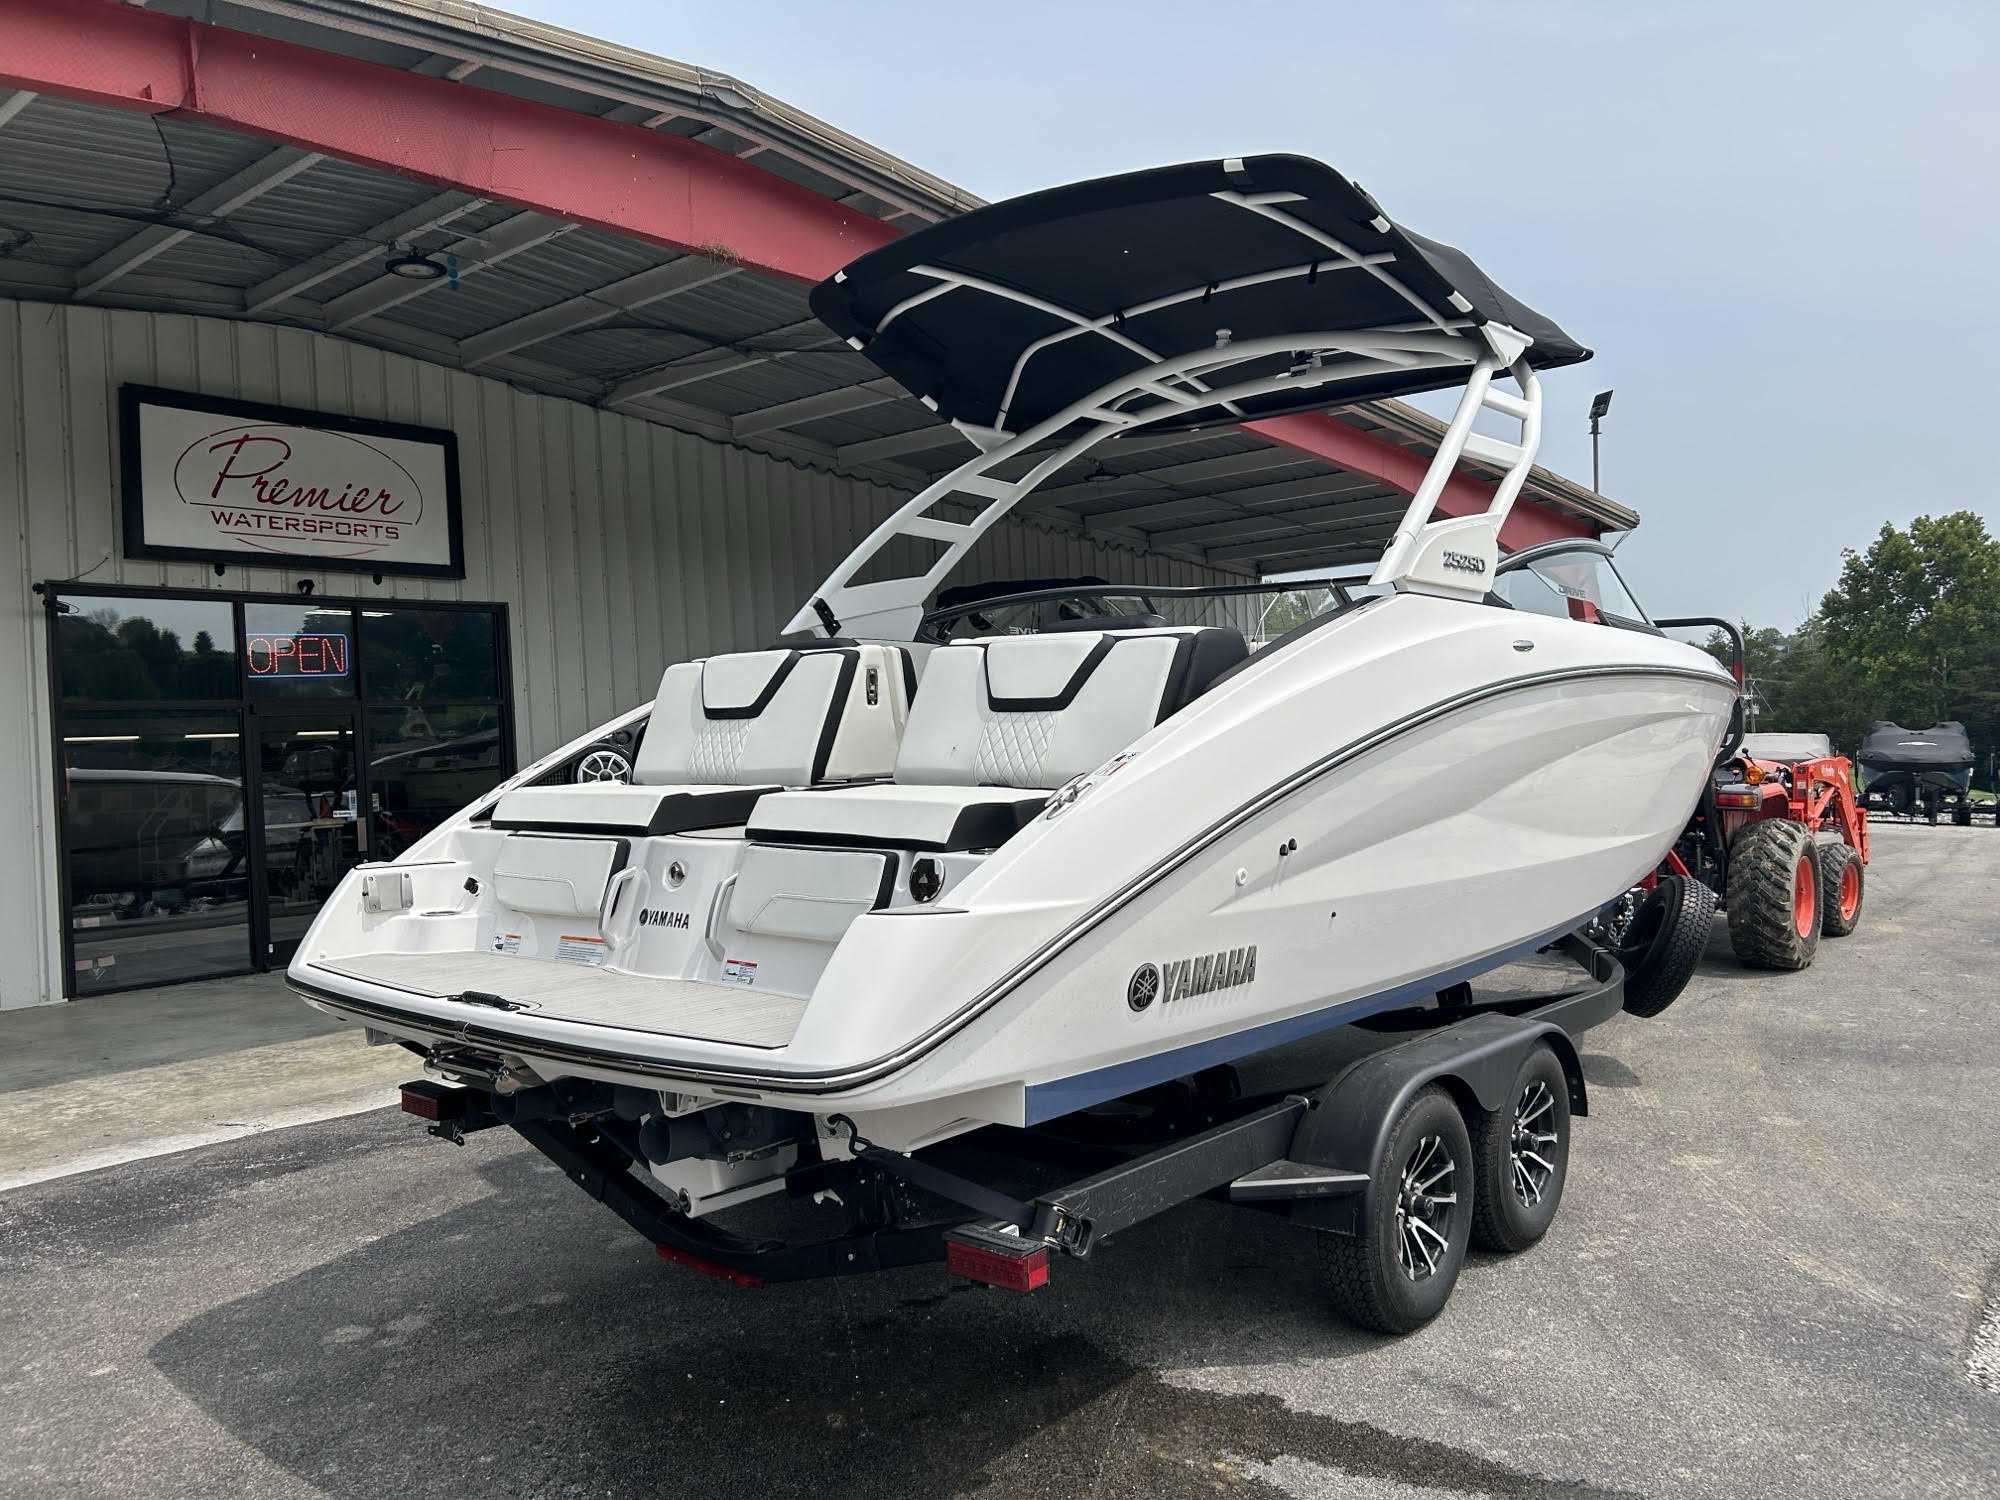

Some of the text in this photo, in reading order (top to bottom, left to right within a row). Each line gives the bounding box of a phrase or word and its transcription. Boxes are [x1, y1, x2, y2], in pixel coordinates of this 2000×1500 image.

[209, 433, 404, 516] Premier
[211, 510, 399, 540] WATERSPORTS
[249, 637, 345, 674] OPEN
[648, 910, 690, 929] YAMAHA
[1162, 945, 1258, 1003] YAMAHA
